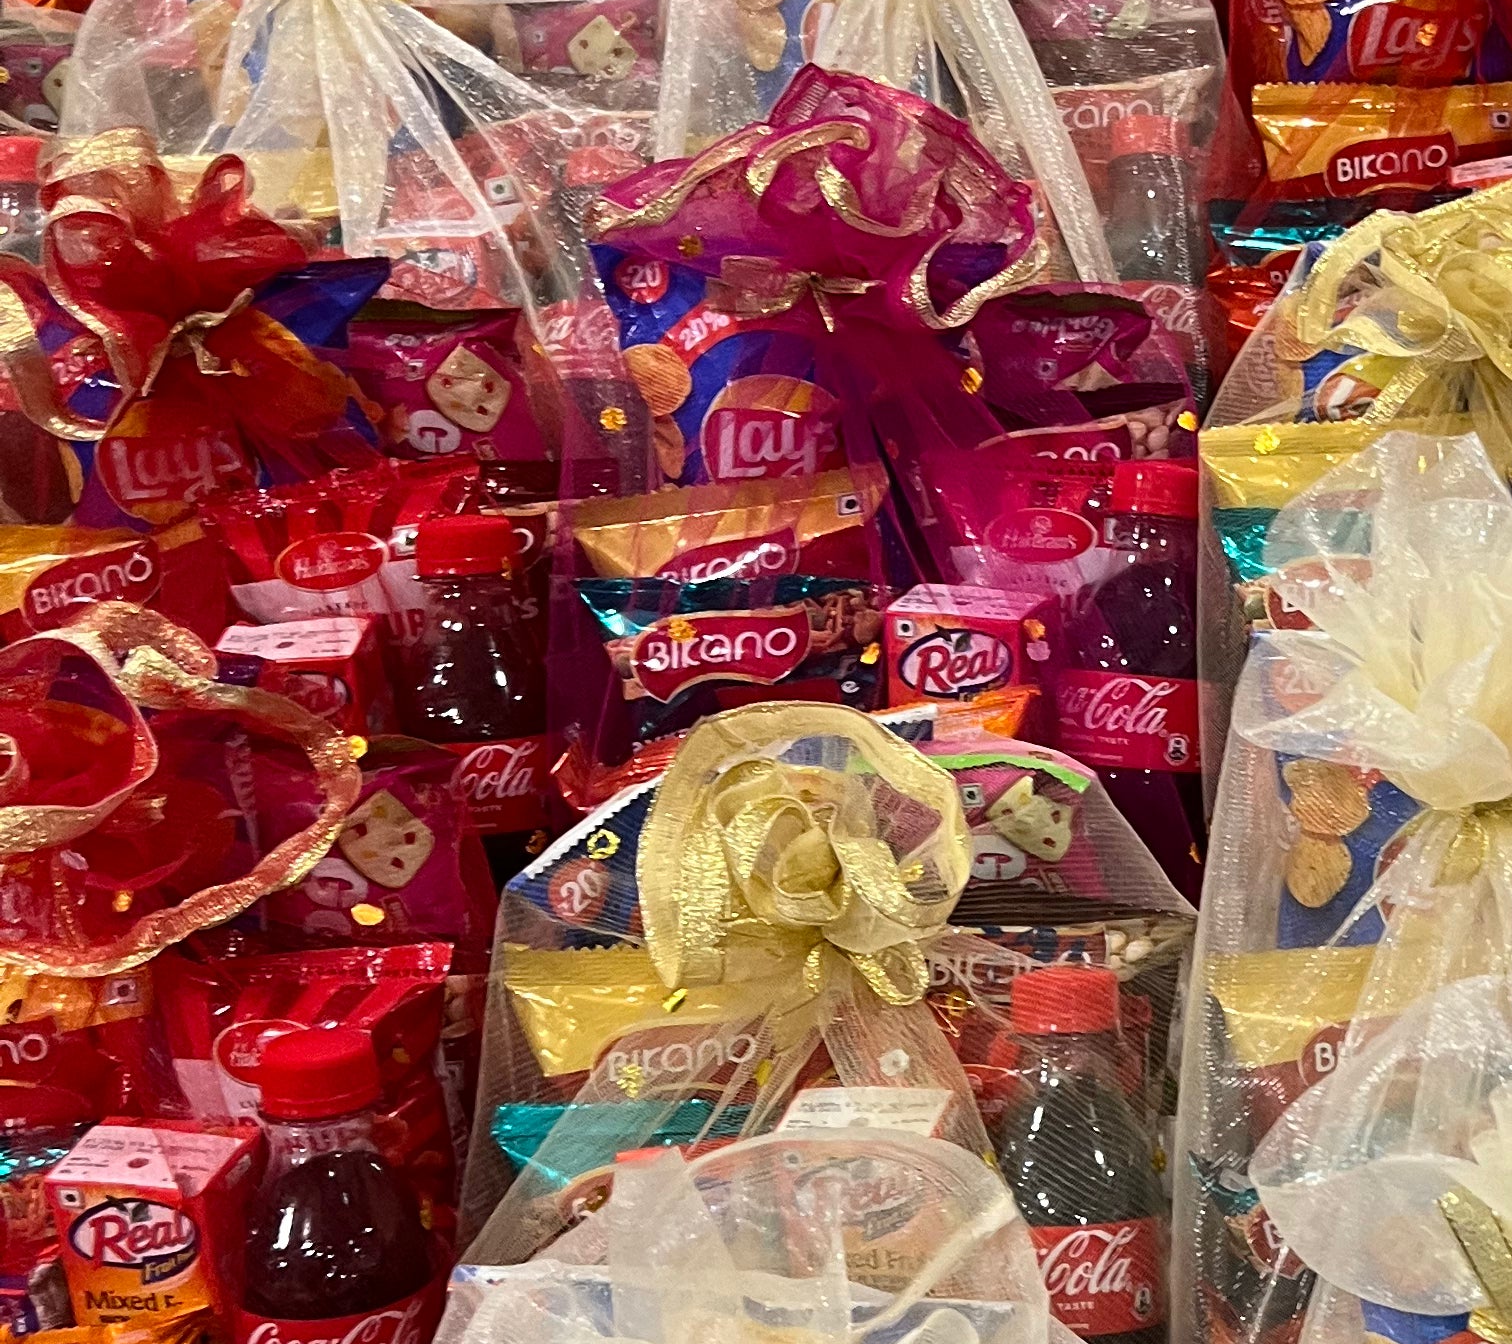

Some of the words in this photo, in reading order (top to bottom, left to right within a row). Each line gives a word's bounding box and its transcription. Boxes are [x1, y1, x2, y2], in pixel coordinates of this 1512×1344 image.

[914, 639, 1003, 694] Real
[89, 1213, 192, 1267] Real
[86, 1289, 159, 1312] Mixed
